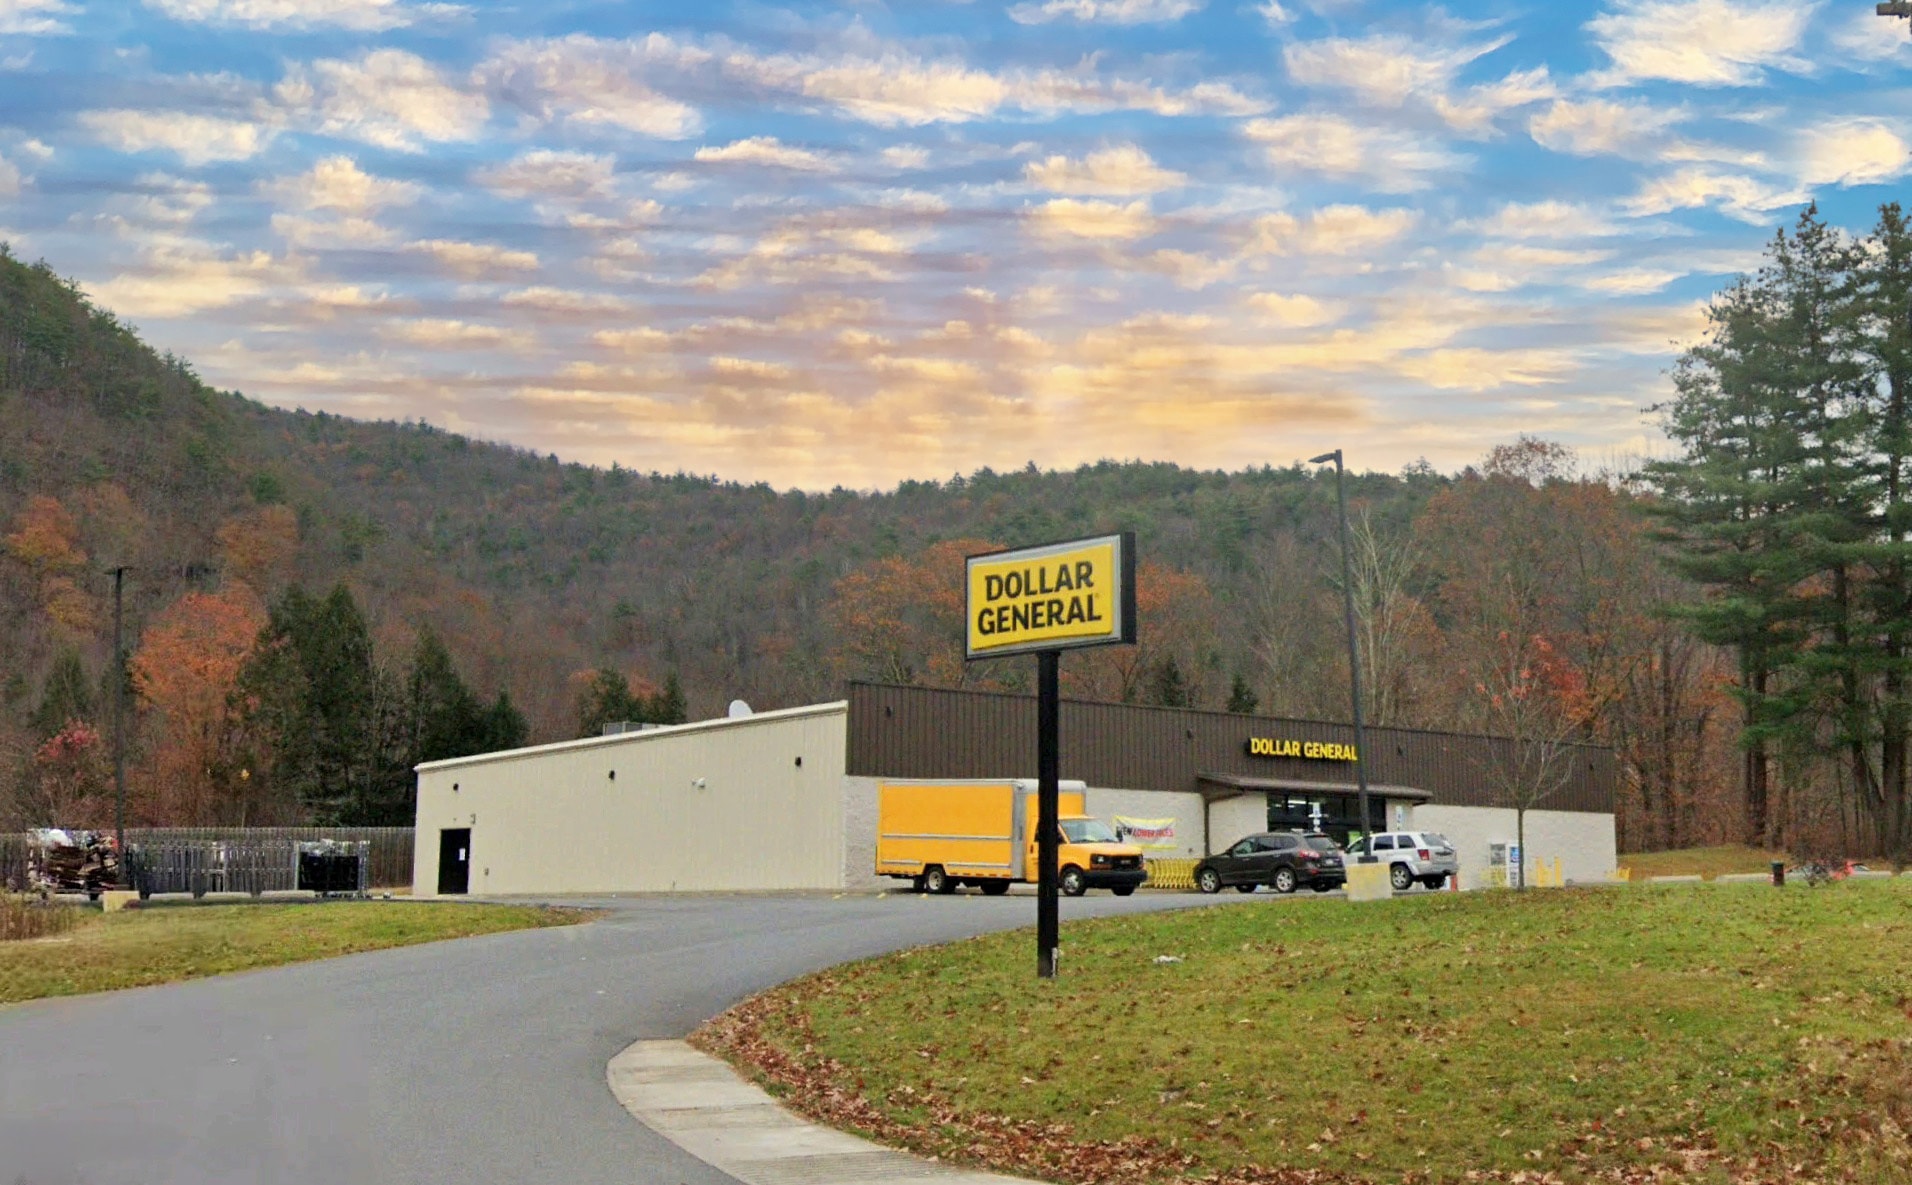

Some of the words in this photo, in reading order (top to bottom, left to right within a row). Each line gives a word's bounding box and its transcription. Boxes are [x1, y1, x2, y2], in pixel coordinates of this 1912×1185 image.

[985, 561, 1094, 601] DOLLAR
[978, 594, 1102, 635] GENERAL
[1251, 738, 1300, 756] DOLLAR
[1303, 742, 1358, 761] GENERAL
